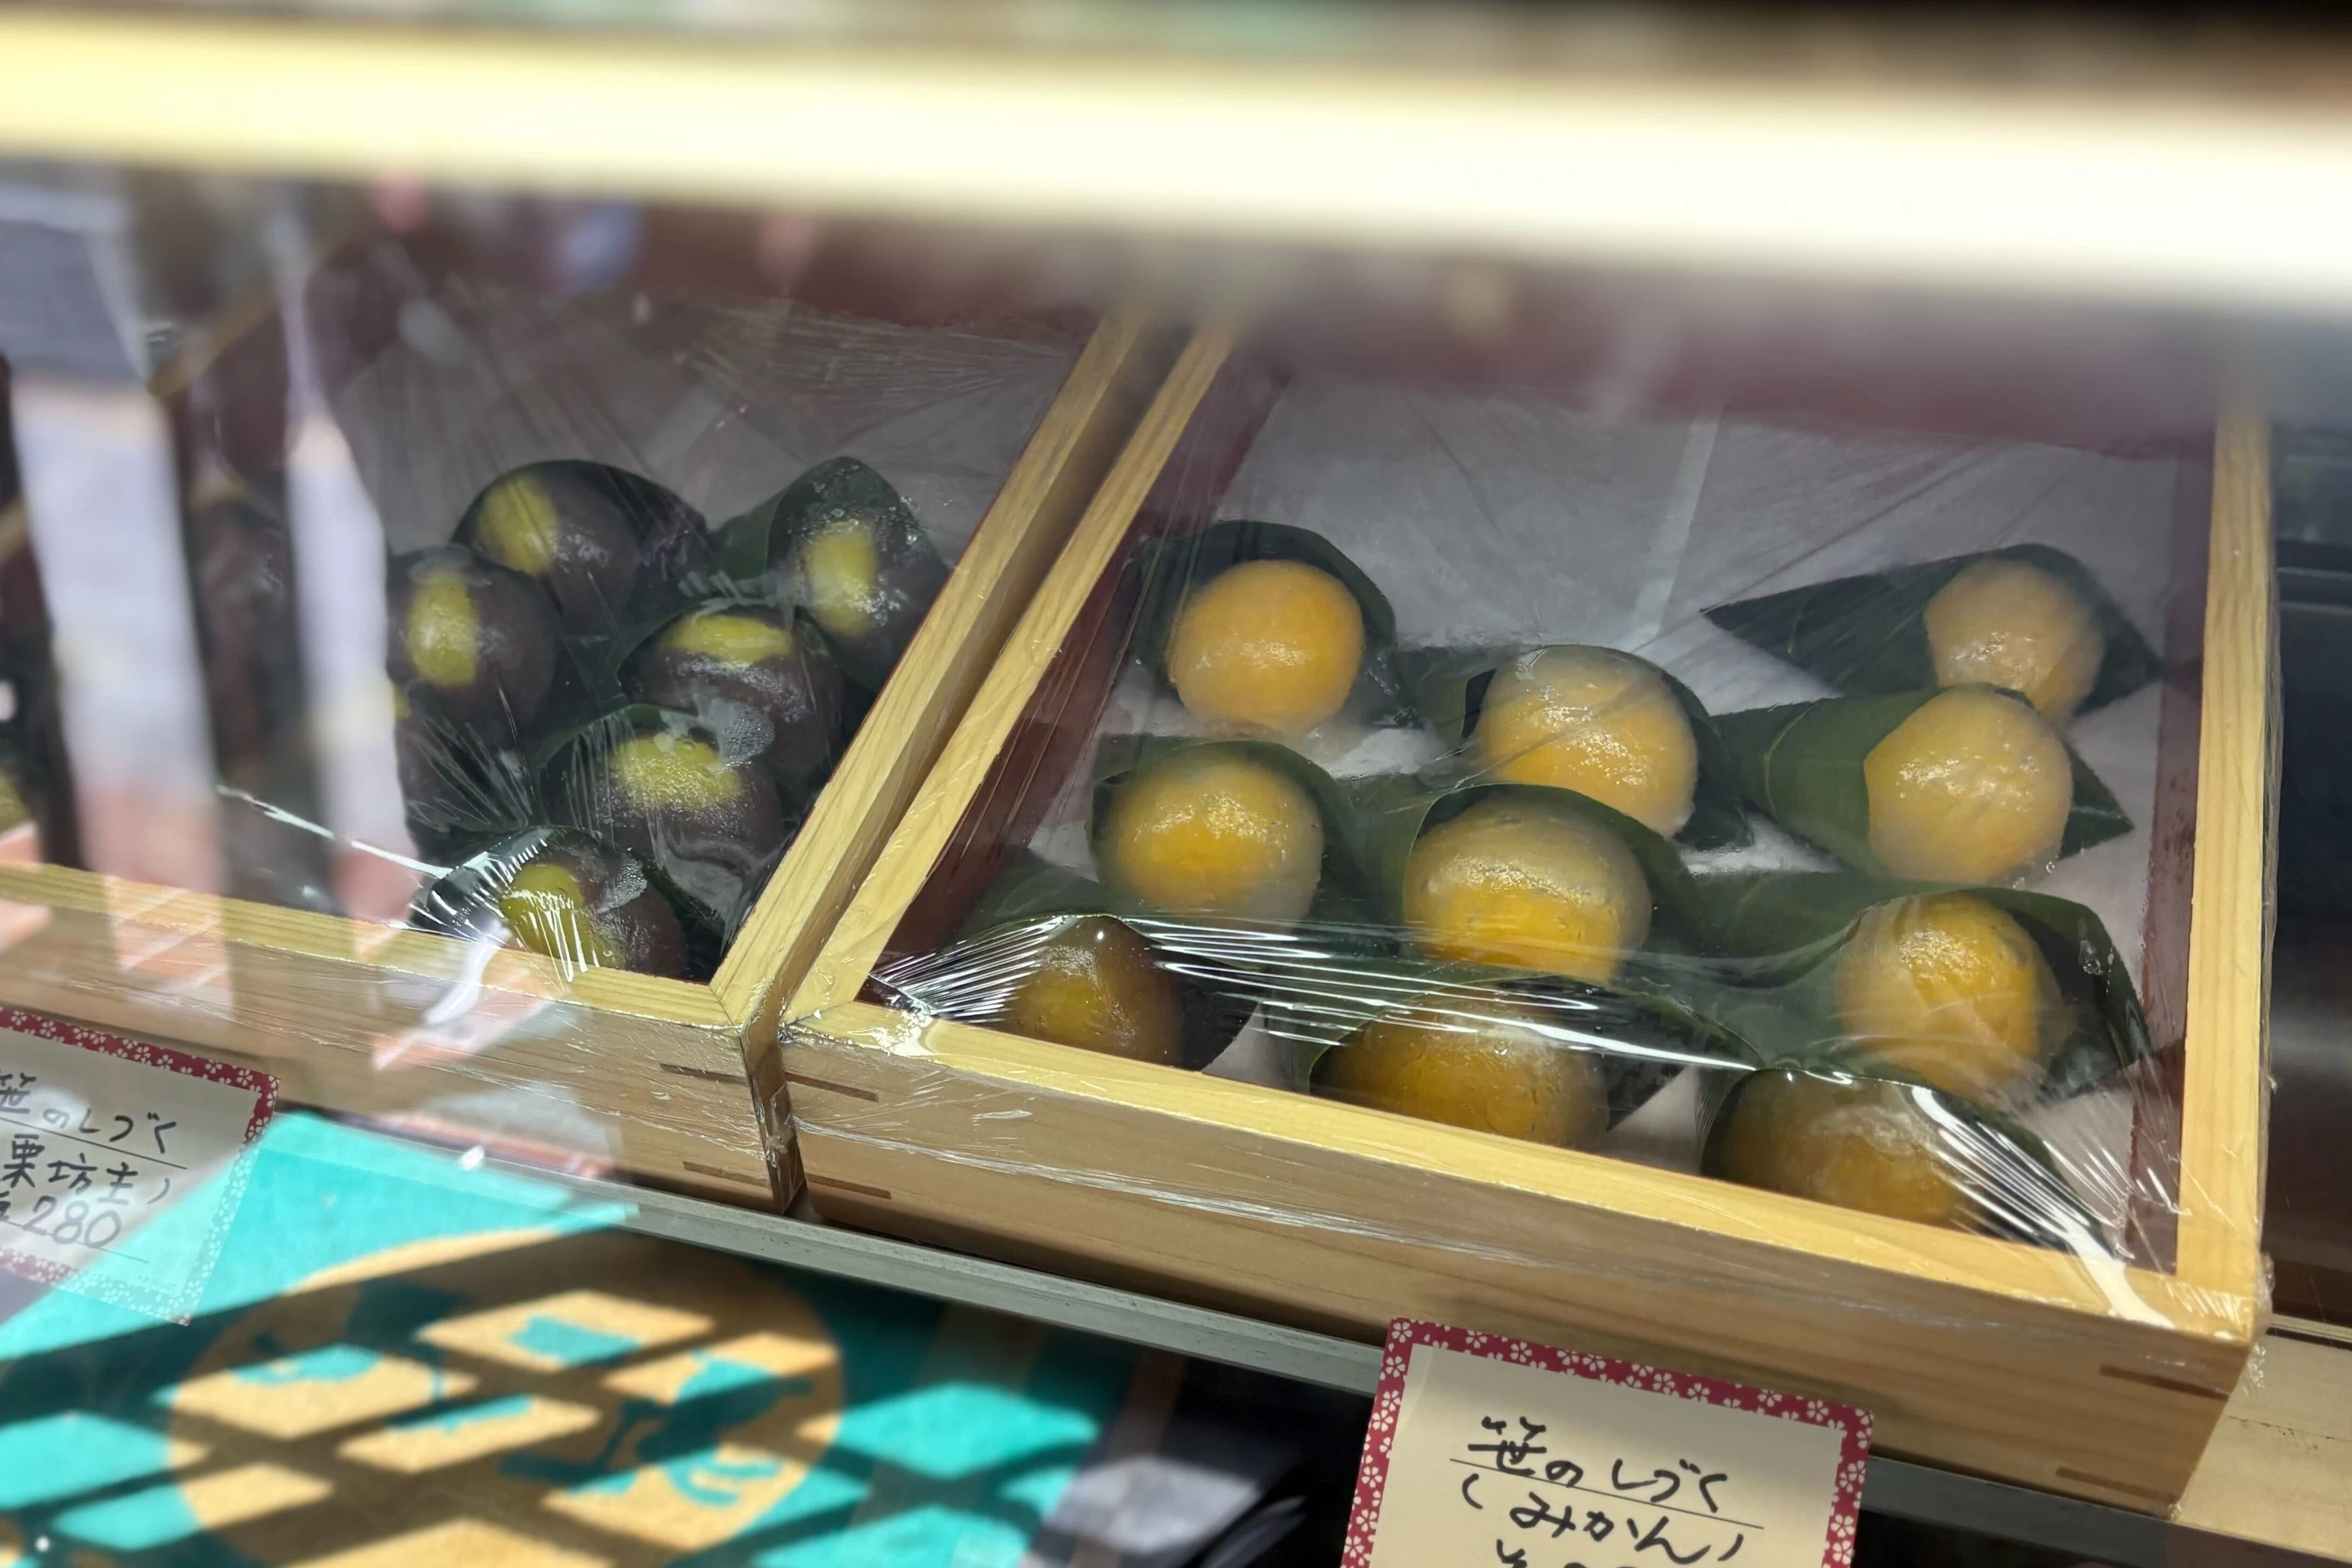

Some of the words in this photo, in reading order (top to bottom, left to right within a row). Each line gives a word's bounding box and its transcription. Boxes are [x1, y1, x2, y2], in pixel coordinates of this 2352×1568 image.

[1467, 1415, 1729, 1514] 笹のしづく
